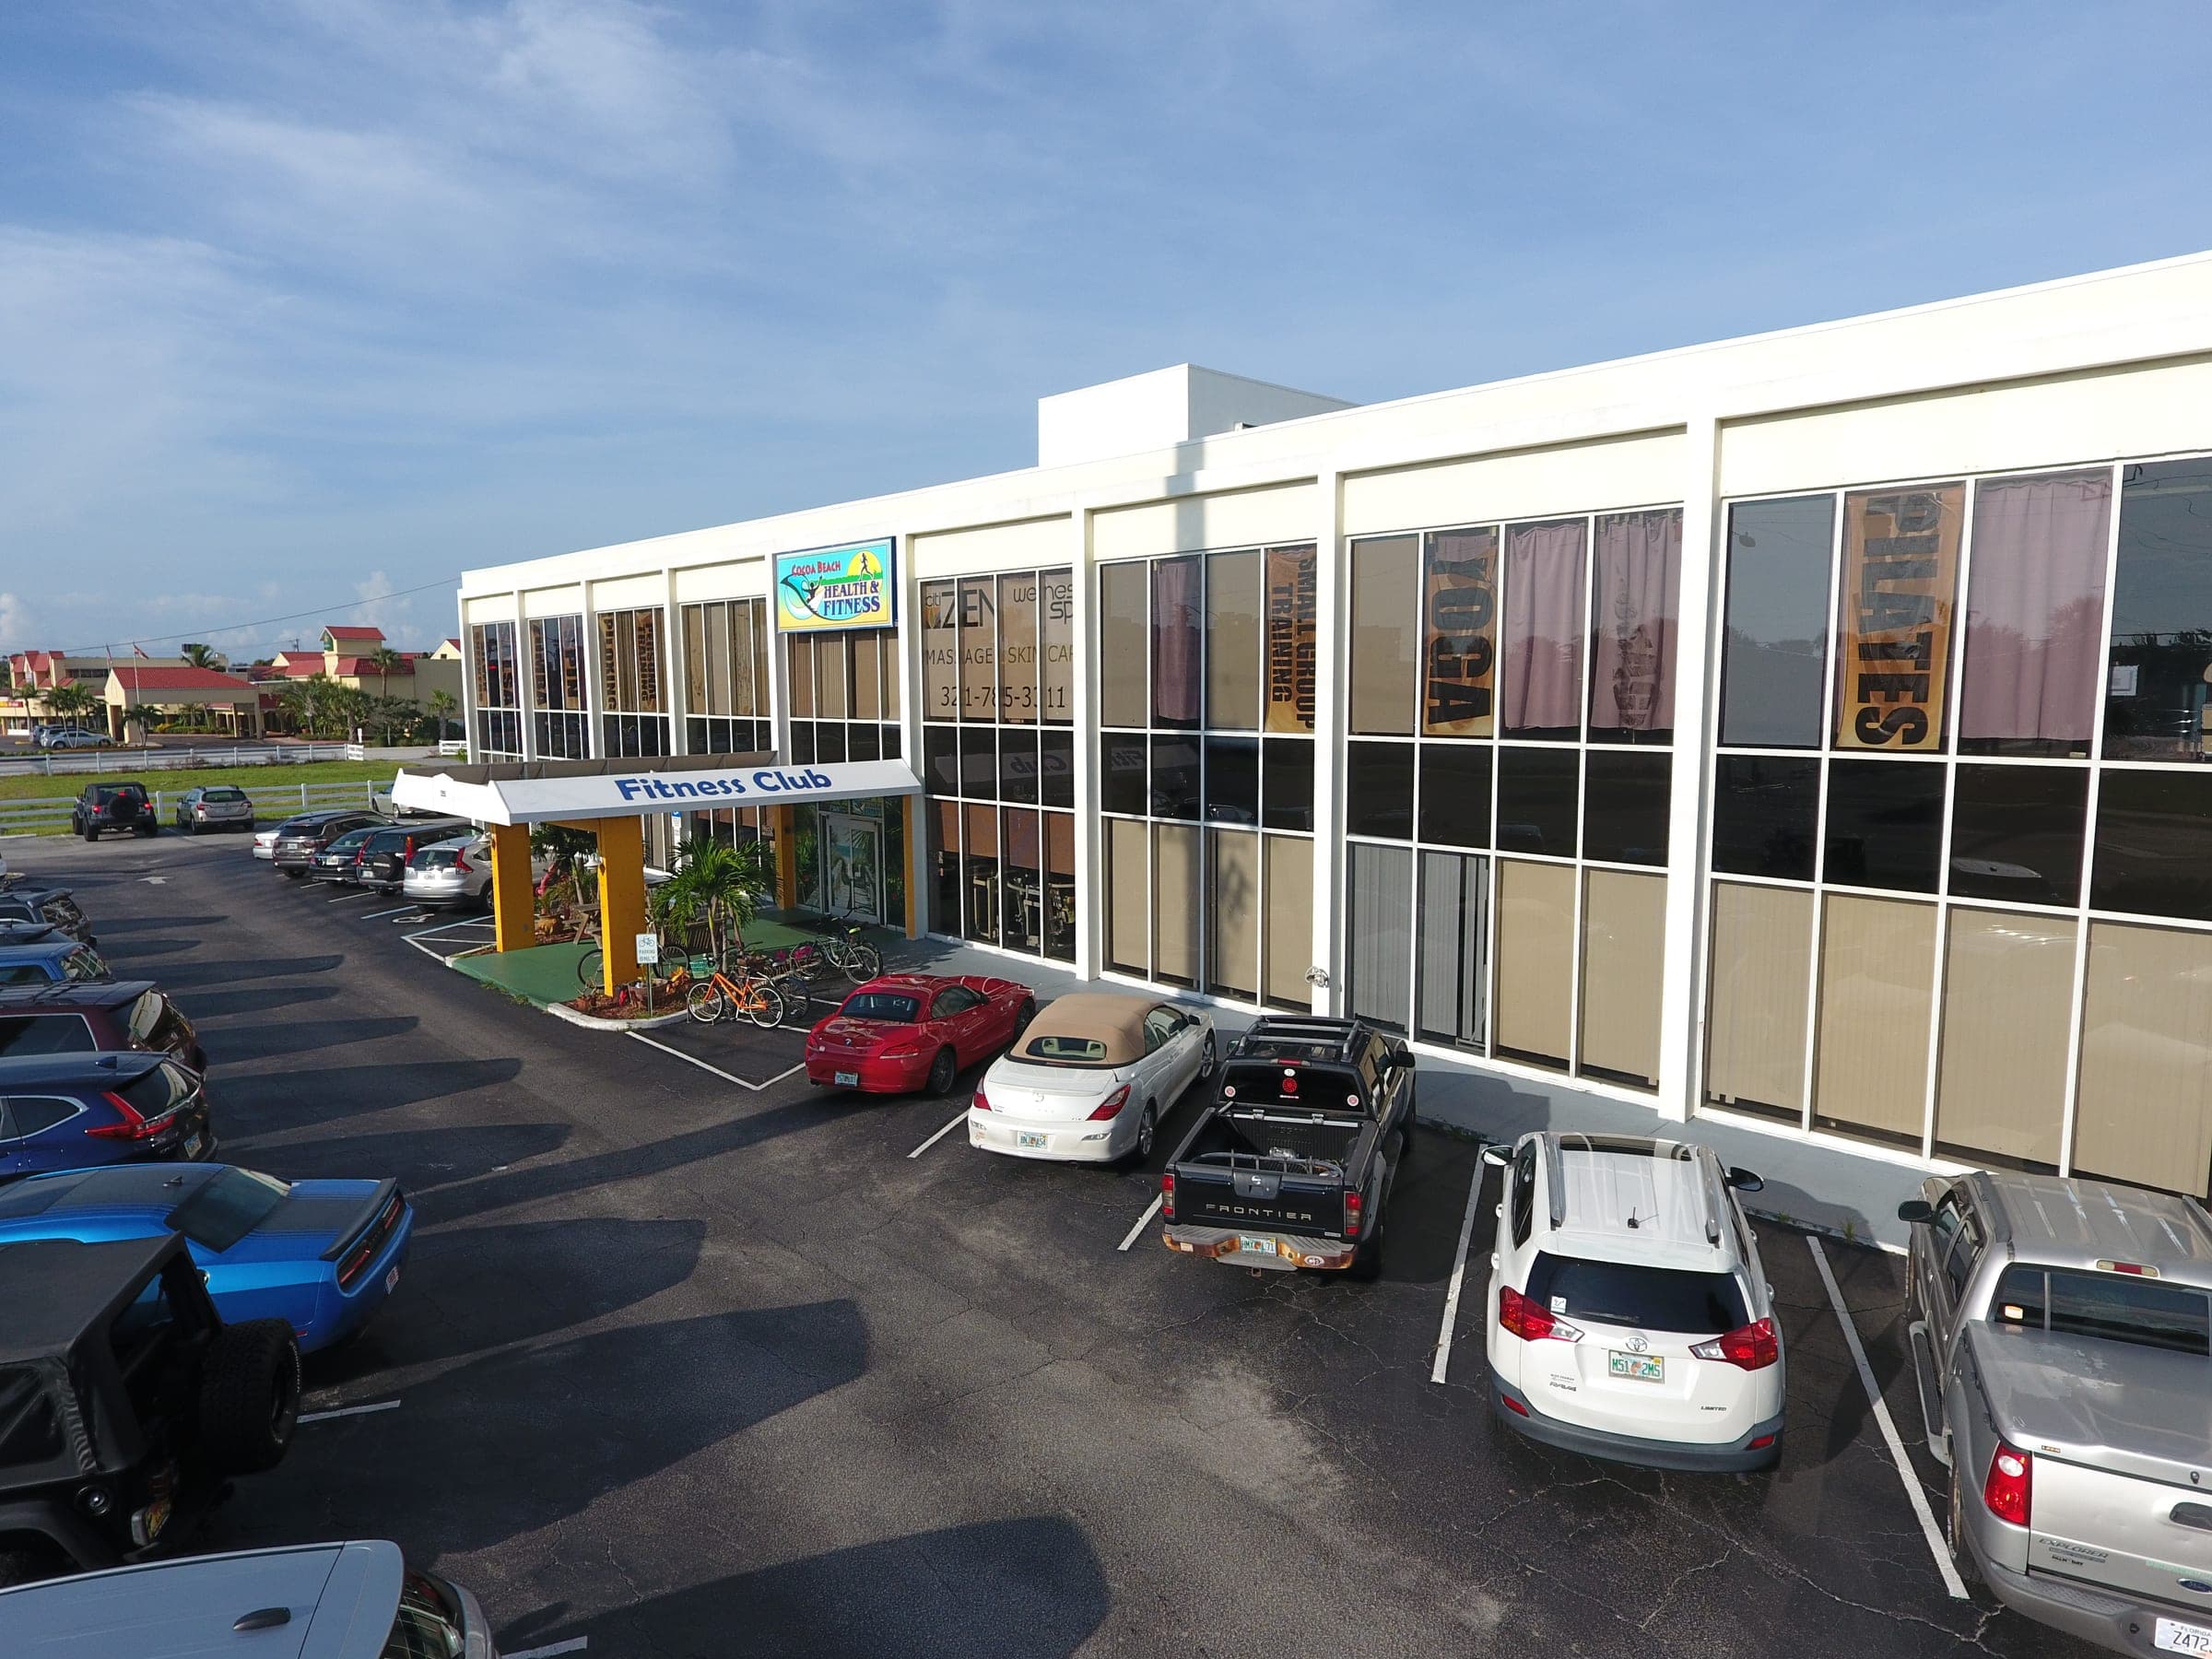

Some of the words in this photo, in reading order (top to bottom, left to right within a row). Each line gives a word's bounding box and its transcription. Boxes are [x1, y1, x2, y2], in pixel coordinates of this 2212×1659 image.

[792, 563, 816, 576] COCOA
[817, 560, 841, 572] BEACH
[824, 582, 867, 599] HEALTH
[870, 580, 878, 594] &
[1296, 558, 1316, 635] SMALL
[823, 595, 880, 616] FITNESS
[1049, 600, 1073, 624] sp
[1854, 494, 1941, 746] PILATES
[1272, 582, 1293, 702] TRAINING
[1428, 557, 1495, 725] YOGA
[926, 647, 994, 665] MASAGE
[1048, 644, 1073, 664] CA
[1295, 642, 1316, 729] GROUP
[614, 777, 746, 801] Fitness
[753, 769, 832, 792] Club
[1206, 1204, 1312, 1221] FRONTIER
[2039, 1538, 2109, 1559] EXPLORER
[2173, 1630, 2212, 1653] Z472
[2181, 1625, 2211, 1637] FLORIDA
